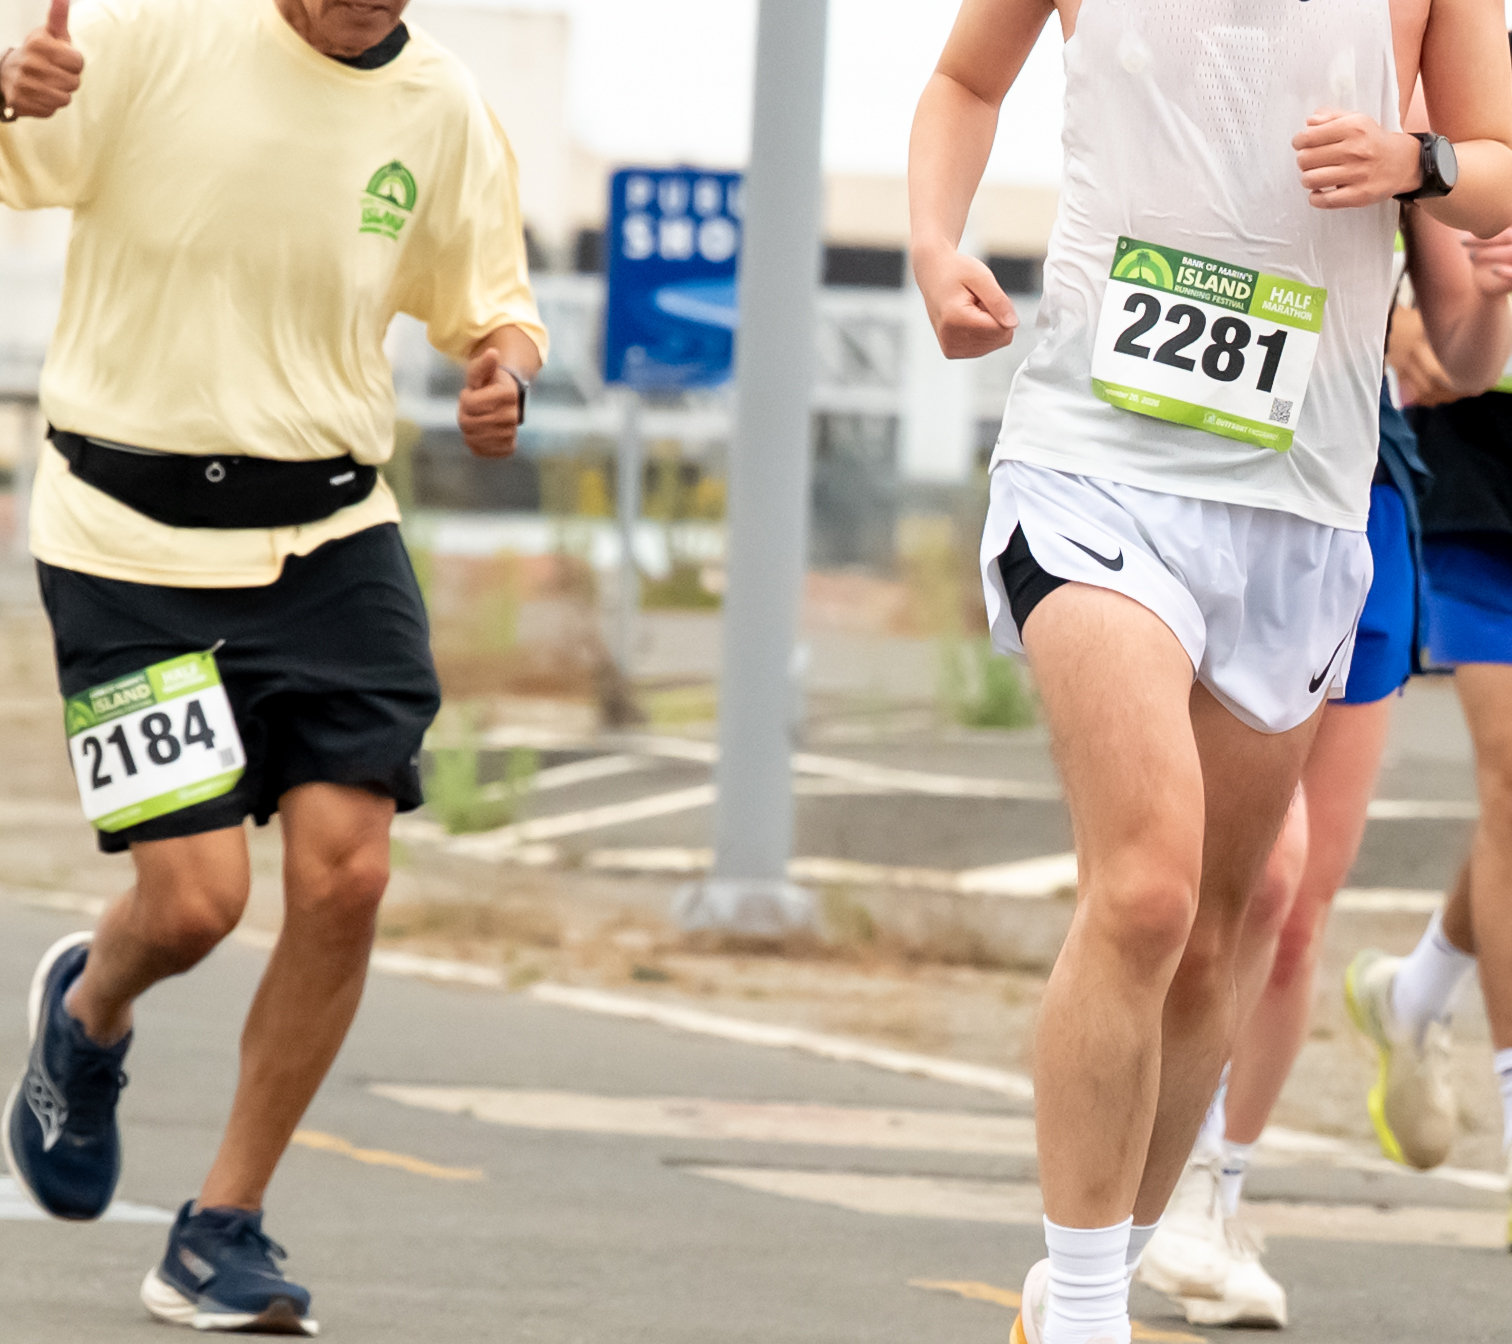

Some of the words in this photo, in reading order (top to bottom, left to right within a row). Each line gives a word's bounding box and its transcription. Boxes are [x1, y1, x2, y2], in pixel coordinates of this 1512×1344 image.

[1176, 266, 1251, 300] ISLAND
[1181, 256, 1205, 269] BANK
[1205, 261, 1217, 272] OF
[1218, 265, 1253, 283] MARIN'S
[1174, 284, 1211, 301] RUNNING
[1211, 295, 1245, 311] FESTIVAL
[1262, 300, 1313, 322] MARATHON
[1269, 286, 1312, 310] HALF
[1113, 292, 1288, 393] 2281
[83, 699, 215, 790] 2184
